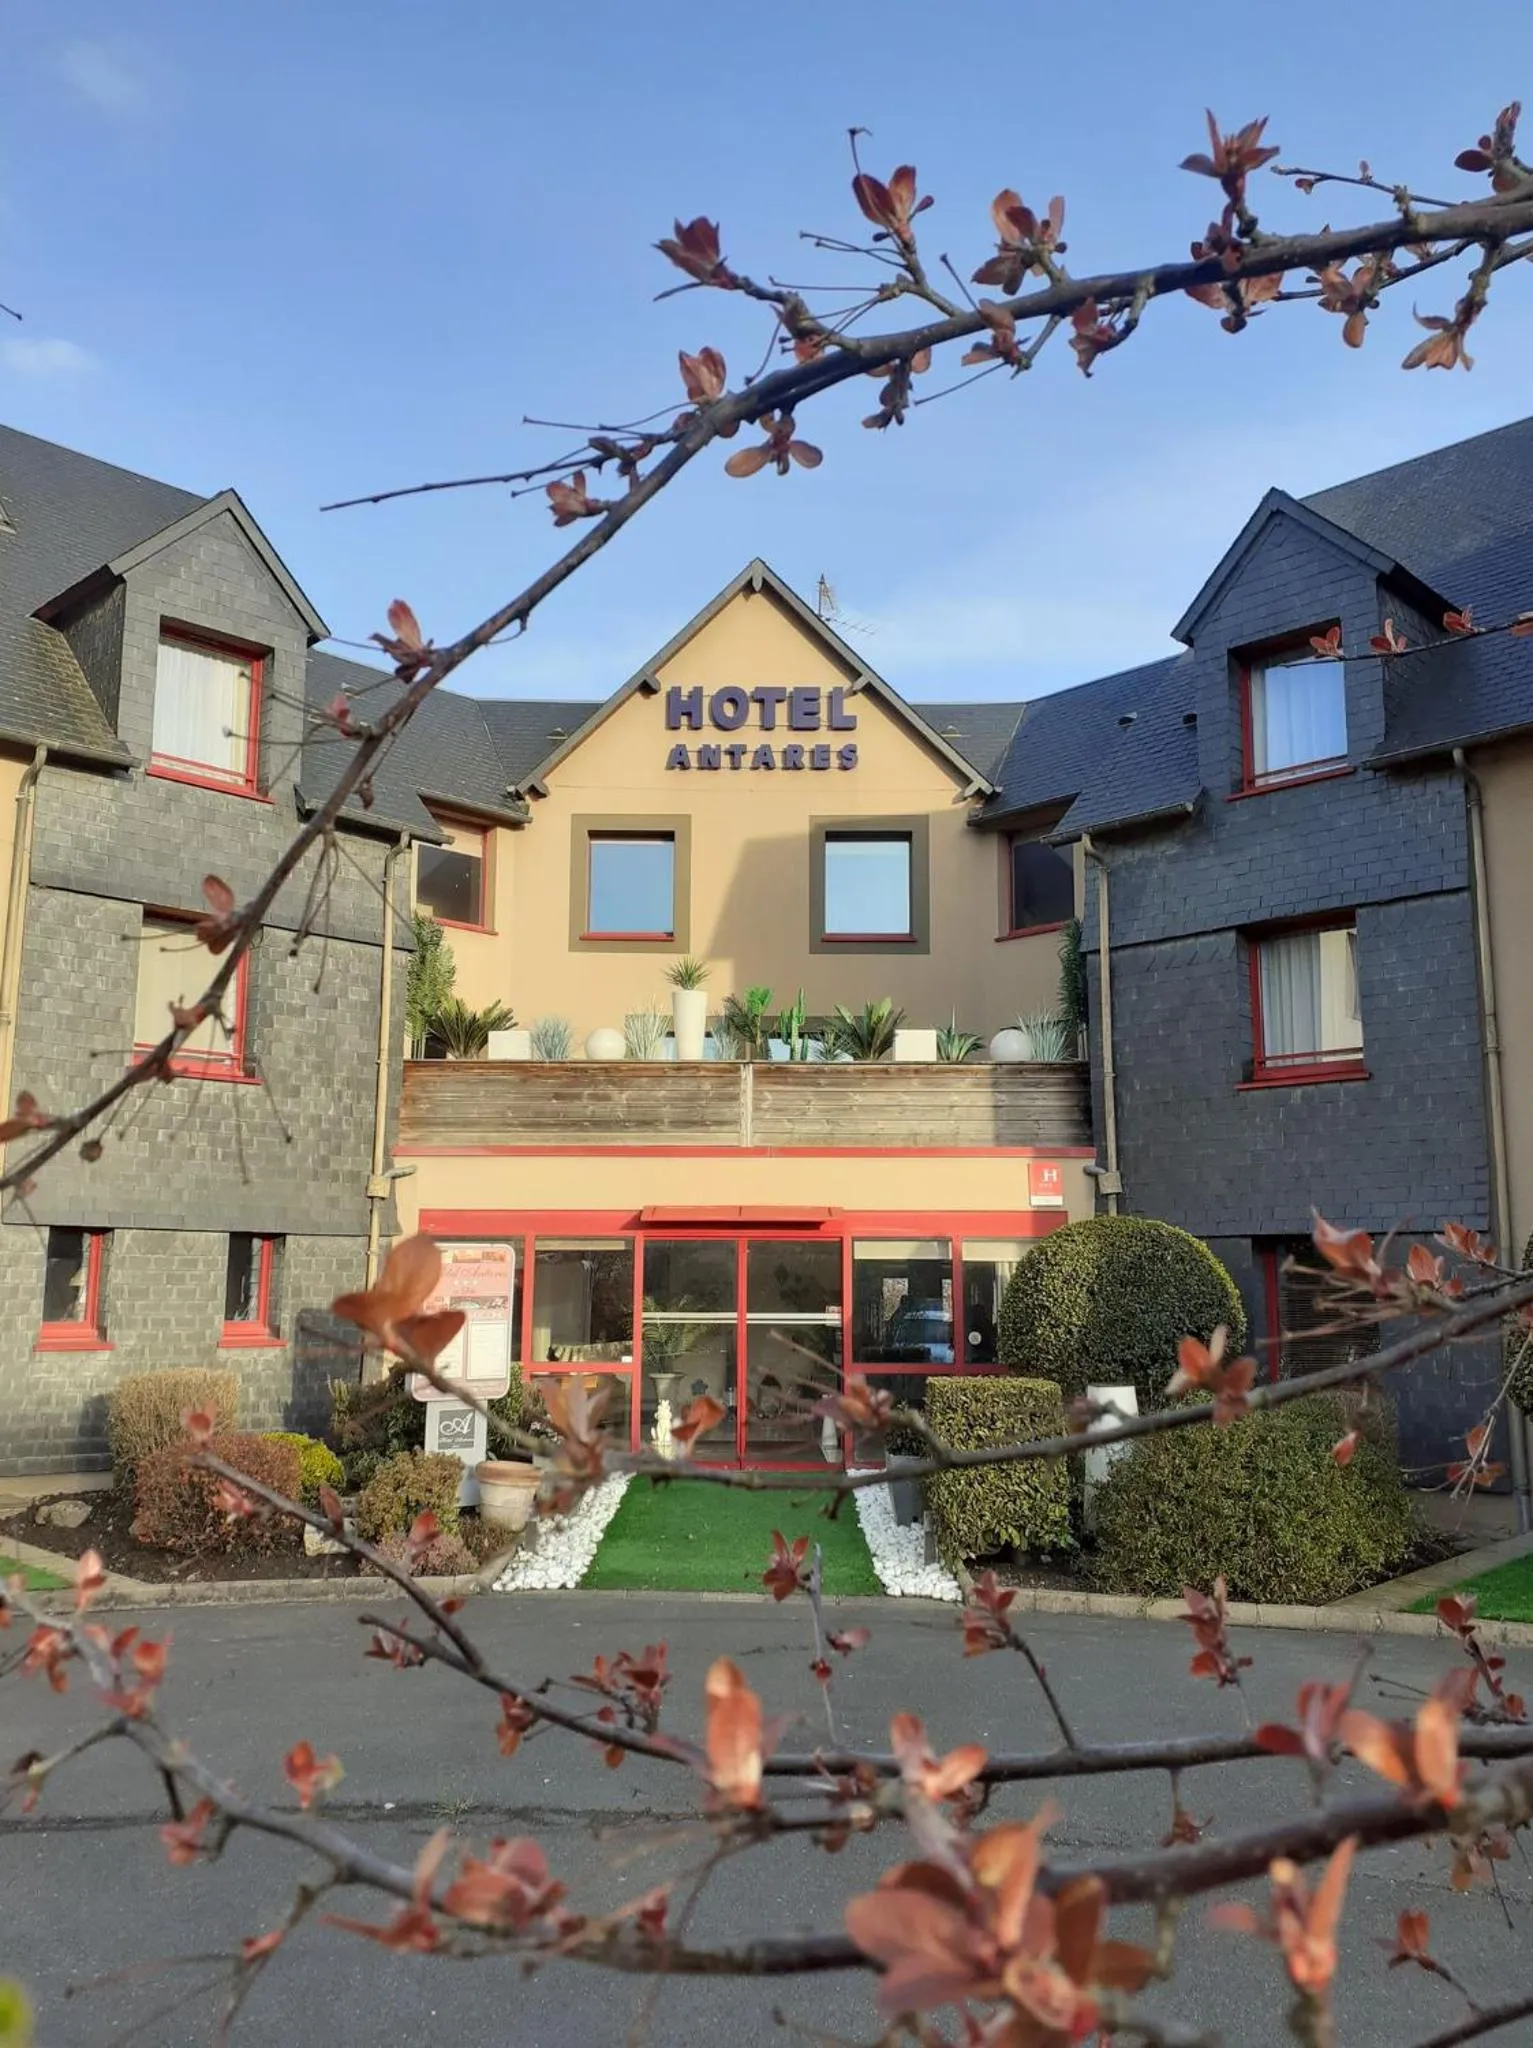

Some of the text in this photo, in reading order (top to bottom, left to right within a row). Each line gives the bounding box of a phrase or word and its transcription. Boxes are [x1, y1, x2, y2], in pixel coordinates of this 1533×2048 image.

[666, 686, 858, 731] HOTEL
[665, 743, 859, 770] ANTARES
[1043, 1168, 1057, 1182] H
